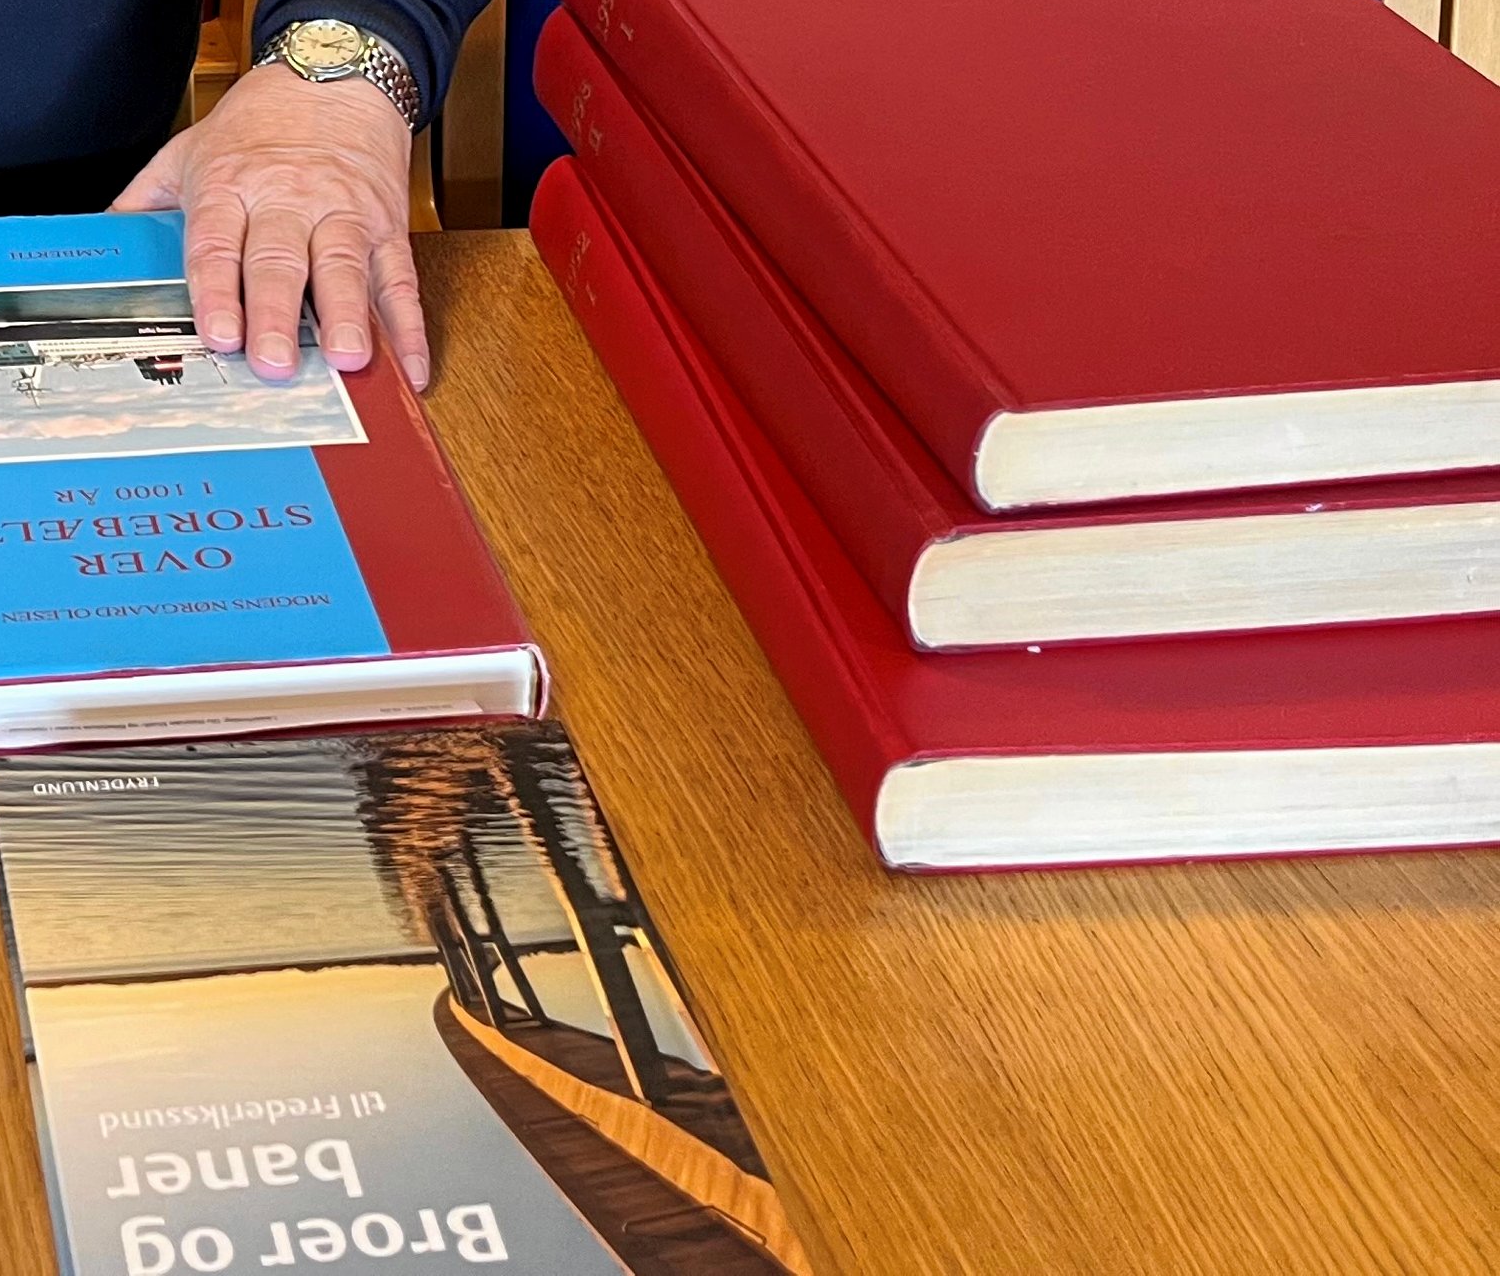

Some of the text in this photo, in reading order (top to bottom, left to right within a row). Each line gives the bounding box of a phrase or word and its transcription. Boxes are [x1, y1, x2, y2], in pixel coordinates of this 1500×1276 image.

[10, 247, 122, 262] LAMBERTH
[54, 481, 213, 506] I 1000 ÅR
[72, 546, 233, 576] OVER
[1, 594, 331, 624] MOGENS NØRGAARD OLESEN
[99, 1090, 387, 1138] til Frederikssund
[106, 1138, 364, 1199] baner
[121, 1202, 509, 1276] Broer og
